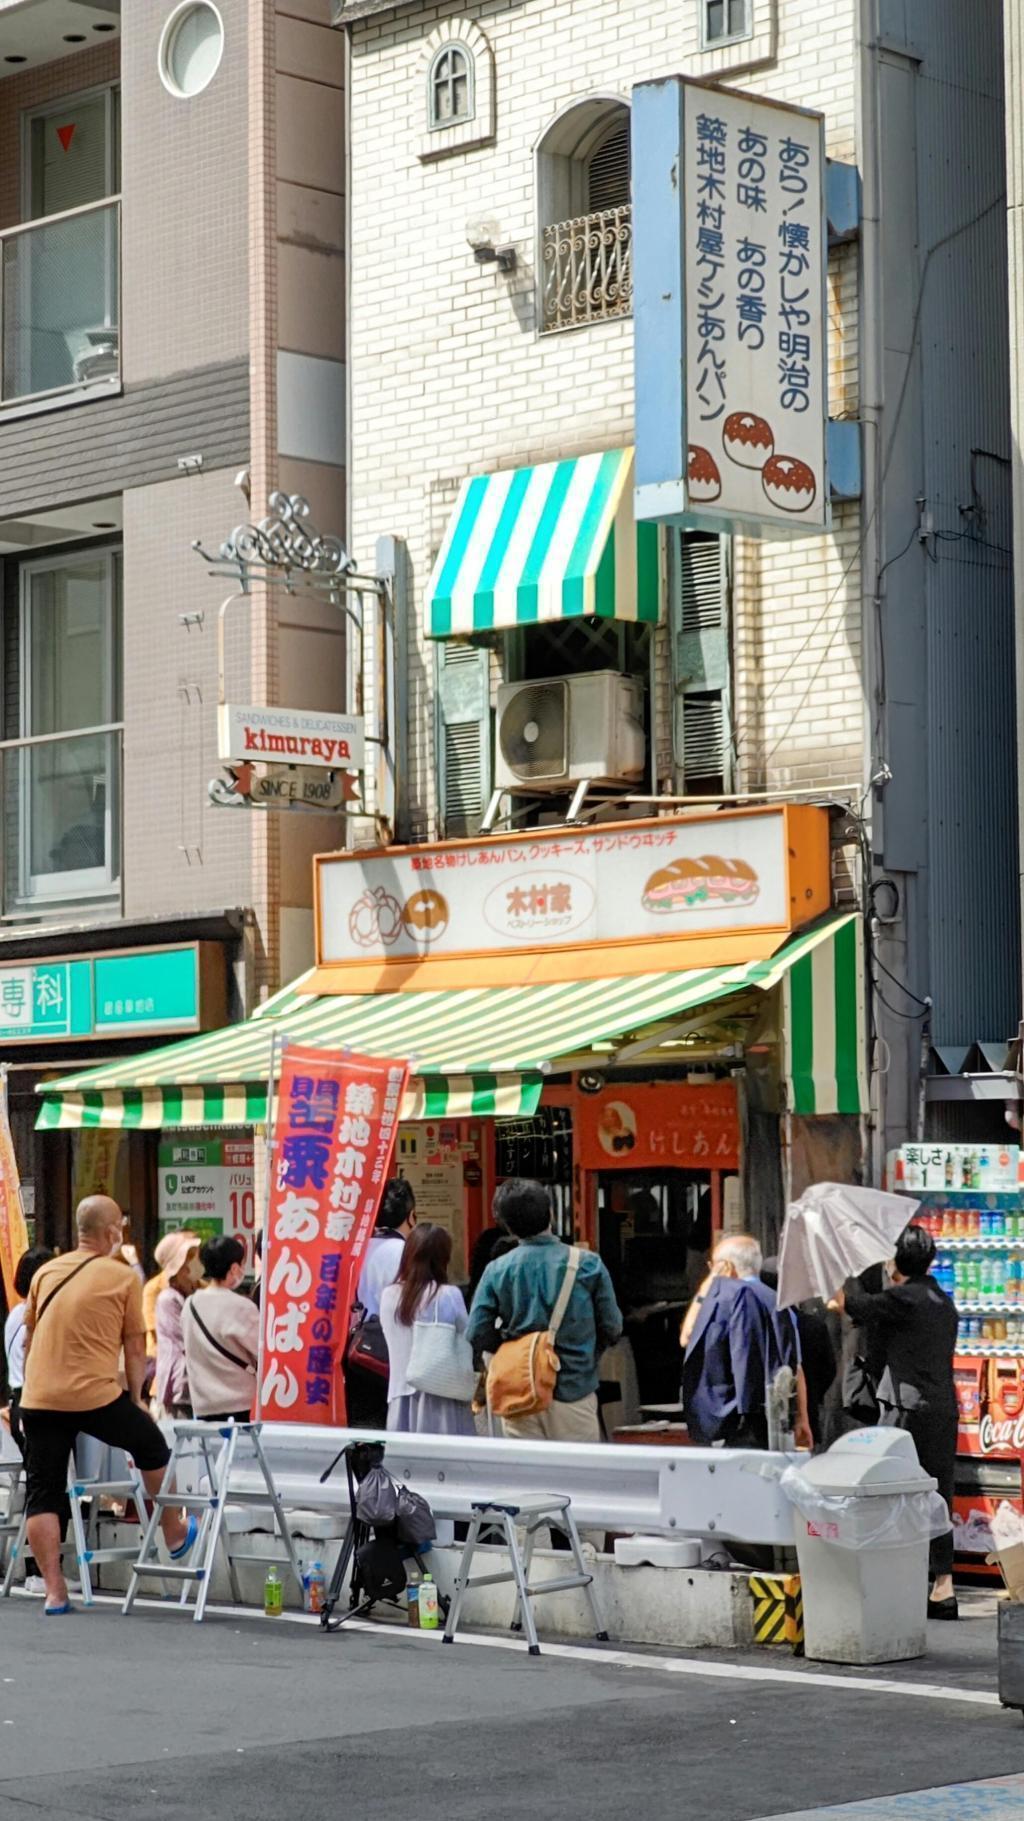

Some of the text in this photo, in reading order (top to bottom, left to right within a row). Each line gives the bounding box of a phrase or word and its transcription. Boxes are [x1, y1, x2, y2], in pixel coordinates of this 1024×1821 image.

[736, 126, 768, 350] あの味 あの香り
[695, 112, 727, 421] 築地木村屋ケシあんパン
[235, 711, 358, 734] SANDWICHES & DELICATESSEN
[243, 726, 351, 762] kimuraya
[259, 780, 332, 800] SINCE 1908
[506, 882, 572, 917] 木村家
[323, 1081, 377, 1243] 築地木村家
[905, 1147, 943, 1166] 楽しさ
[180, 1175, 196, 1184] LINE
